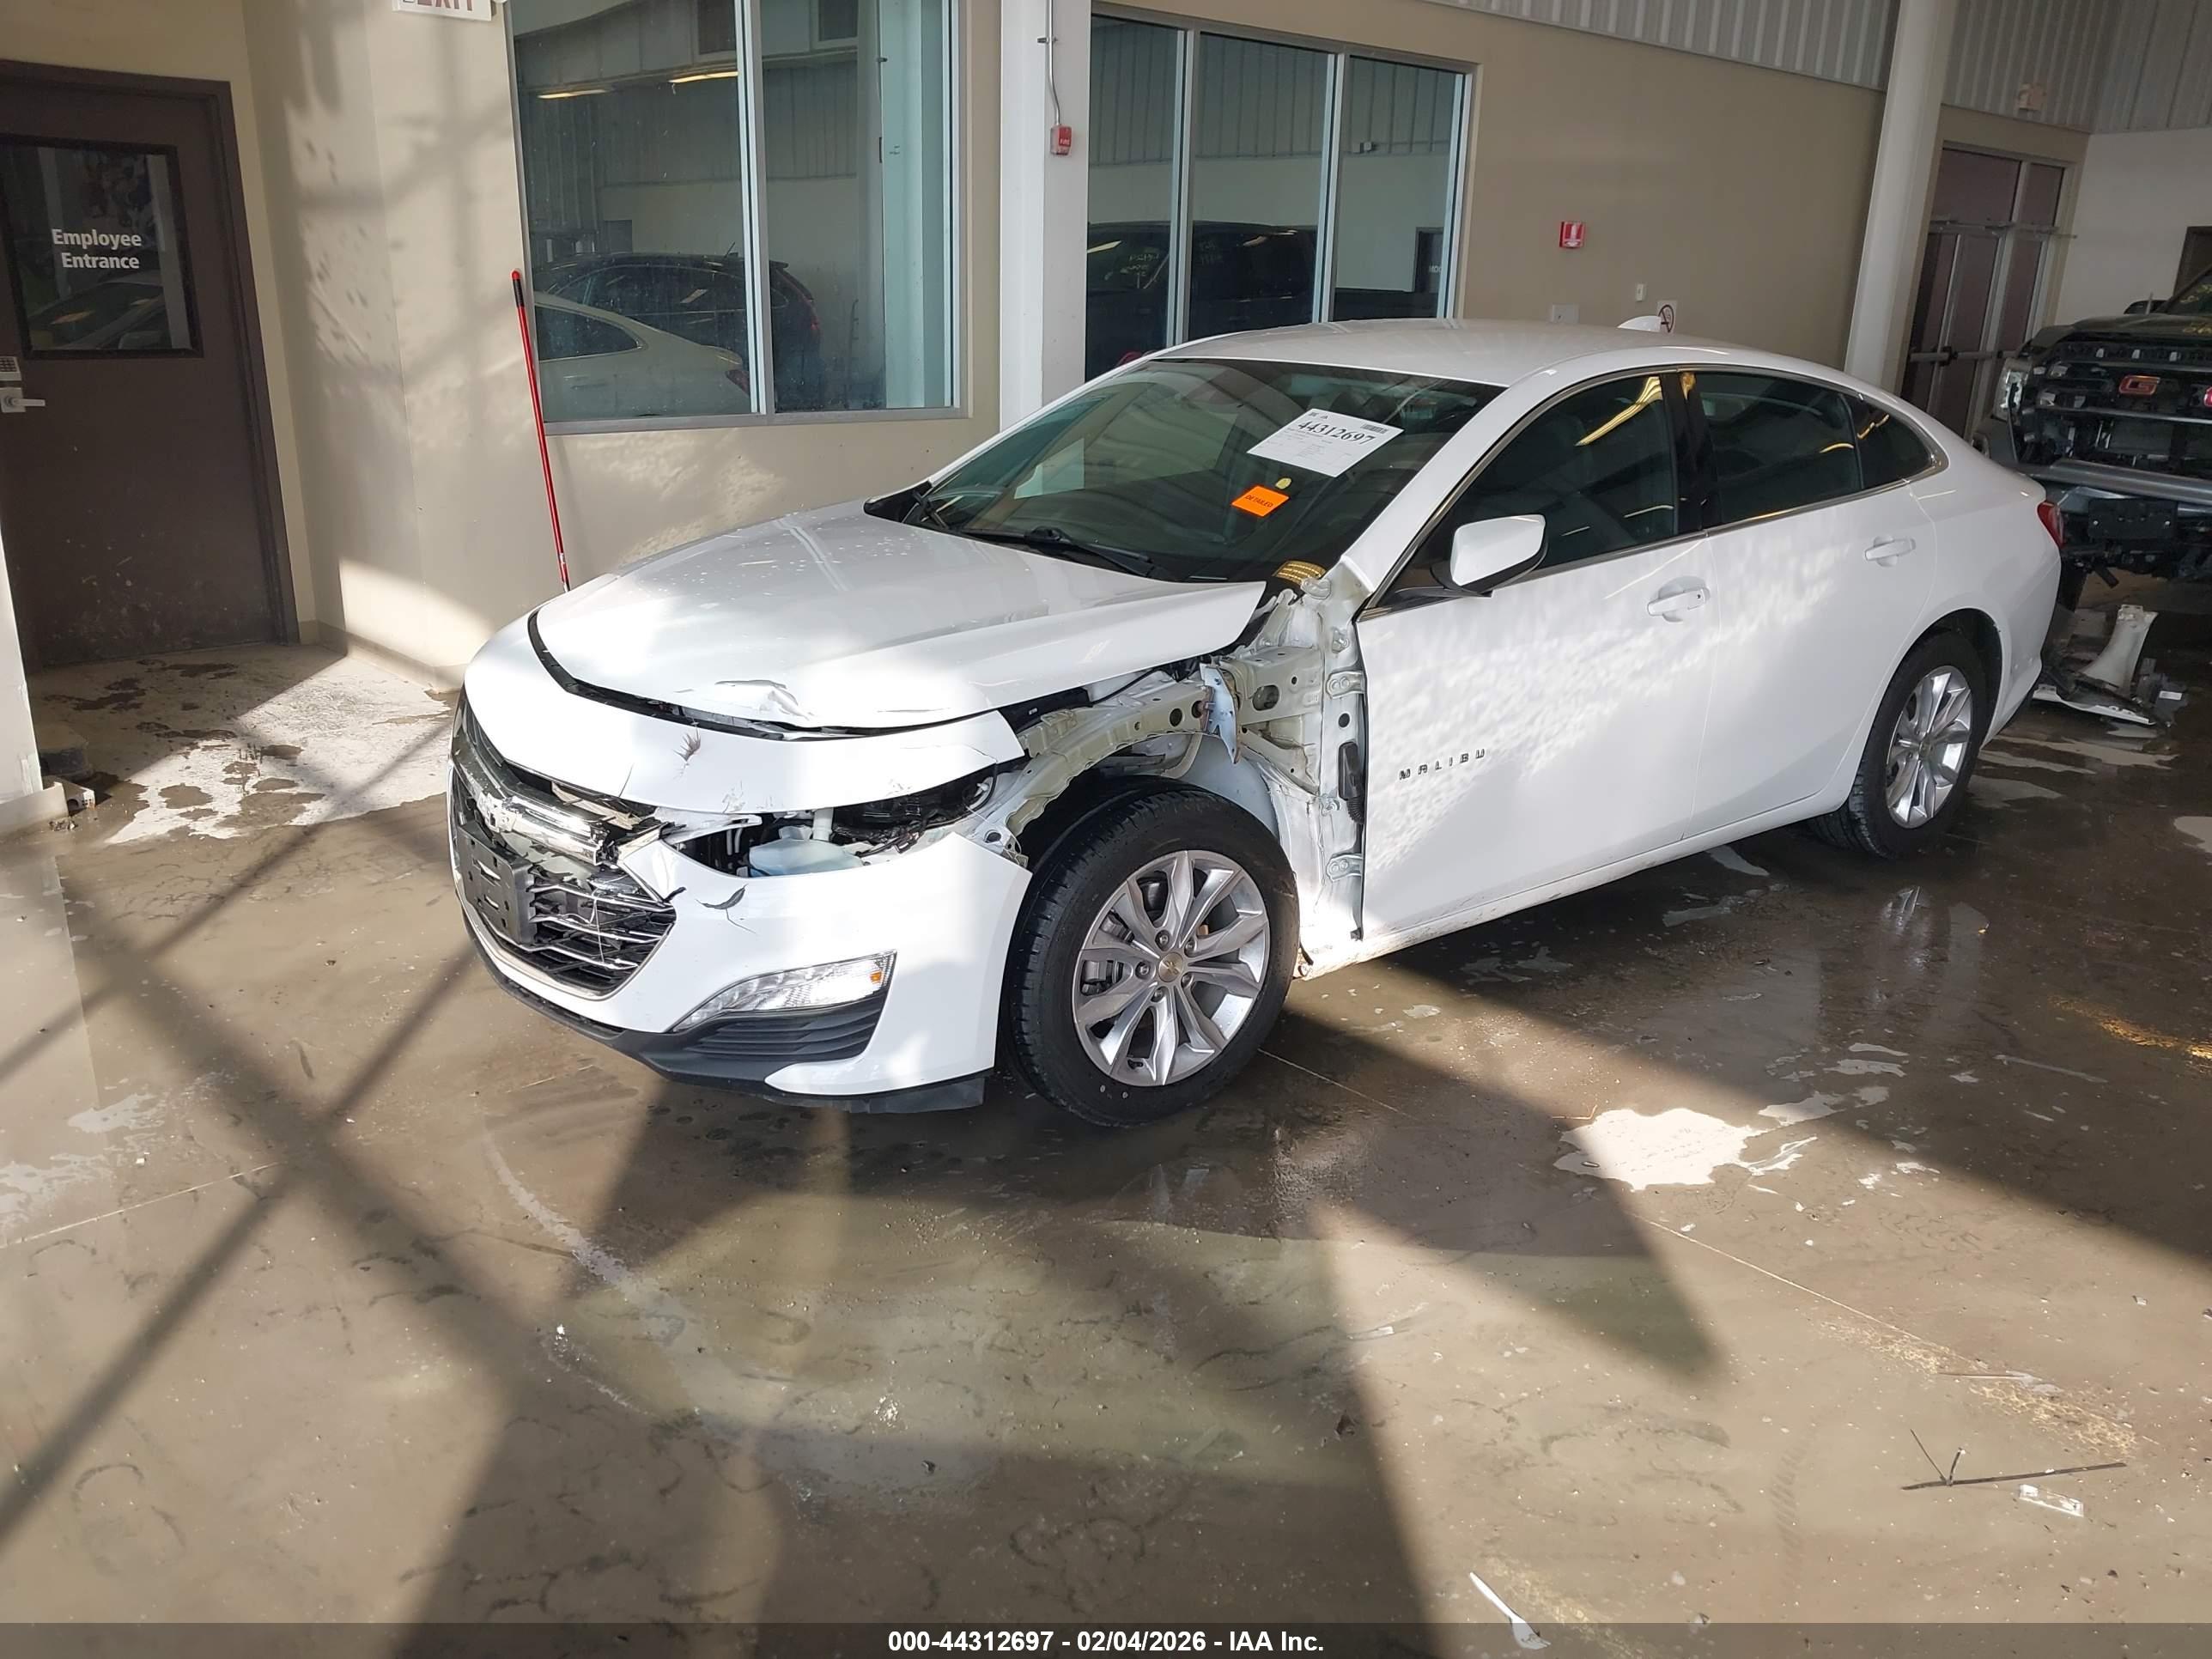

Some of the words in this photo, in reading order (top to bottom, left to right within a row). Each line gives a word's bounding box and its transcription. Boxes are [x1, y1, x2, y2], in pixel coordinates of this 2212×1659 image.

[52, 229, 142, 250] Employee
[61, 252, 140, 269] Entrance
[1297, 421, 1376, 445] 44312697
[1245, 495, 1274, 507] DETAILED
[1399, 748, 1485, 780] MALIBU
